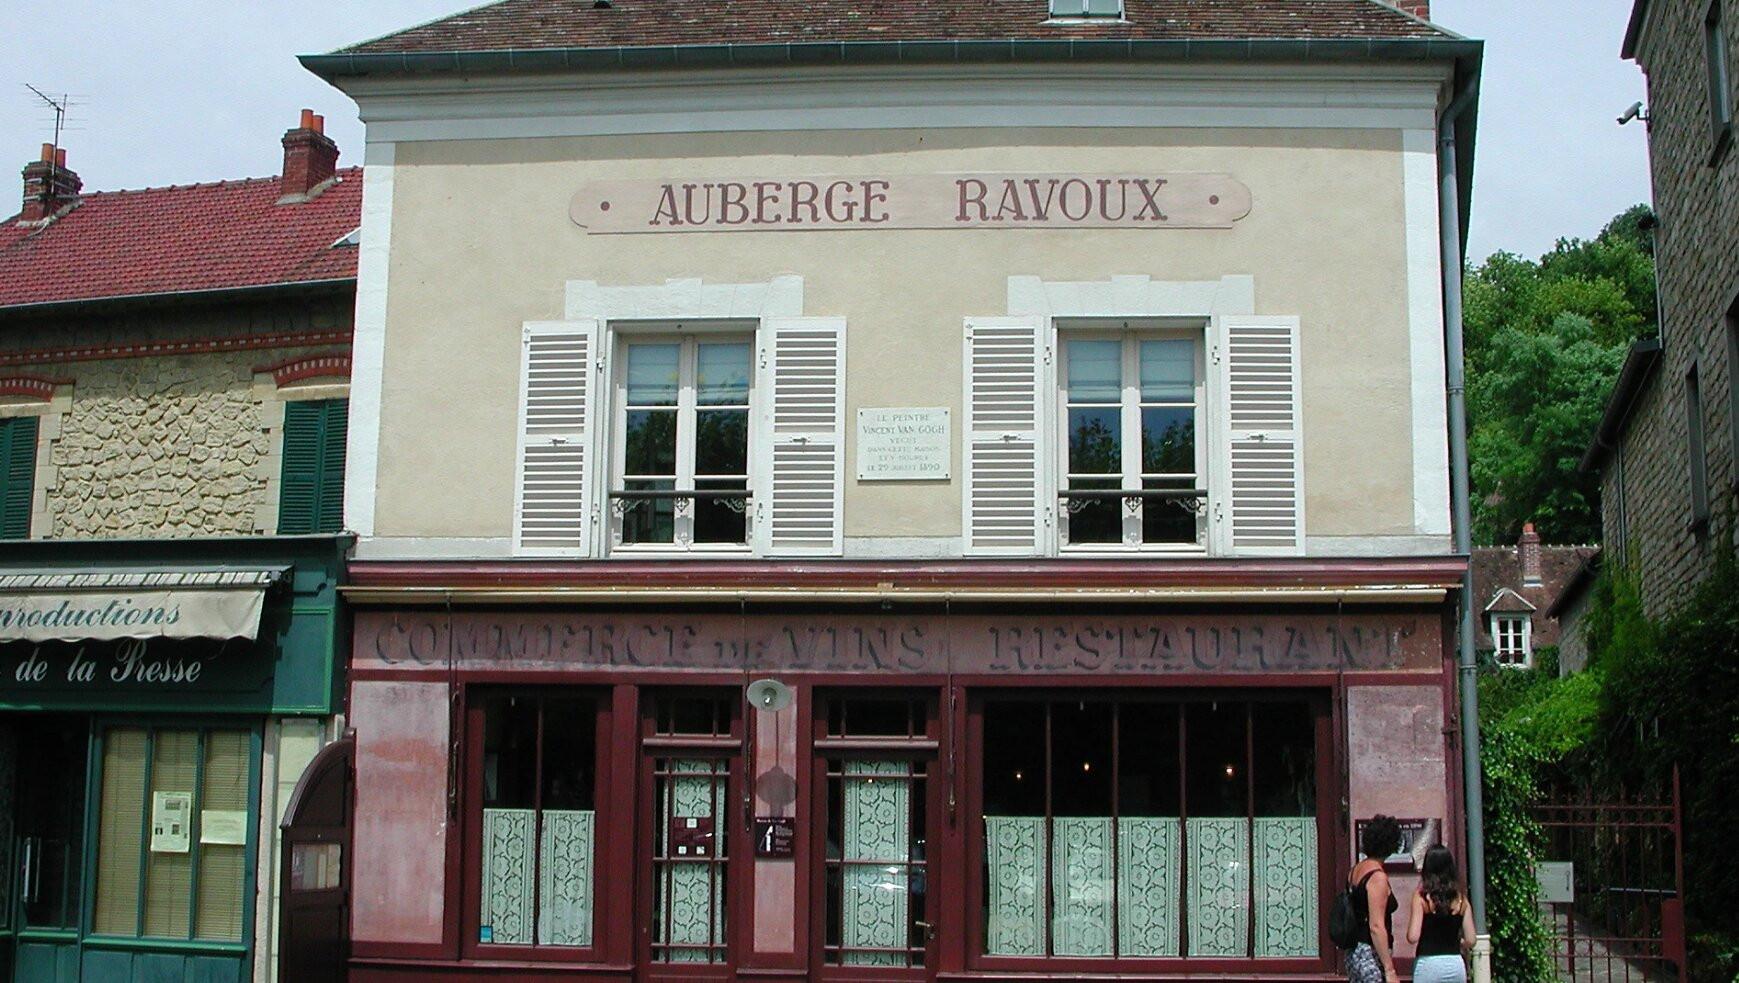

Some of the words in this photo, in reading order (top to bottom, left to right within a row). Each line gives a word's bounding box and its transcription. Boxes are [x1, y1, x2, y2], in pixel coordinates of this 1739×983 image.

[649, 180, 890, 226] AUBERGE
[955, 178, 1168, 221] RAVOUX
[918, 424, 945, 434] GOGH
[15, 645, 47, 682] de
[66, 645, 96, 682] la
[110, 637, 202, 682] Presse
[781, 624, 926, 670] VINS
